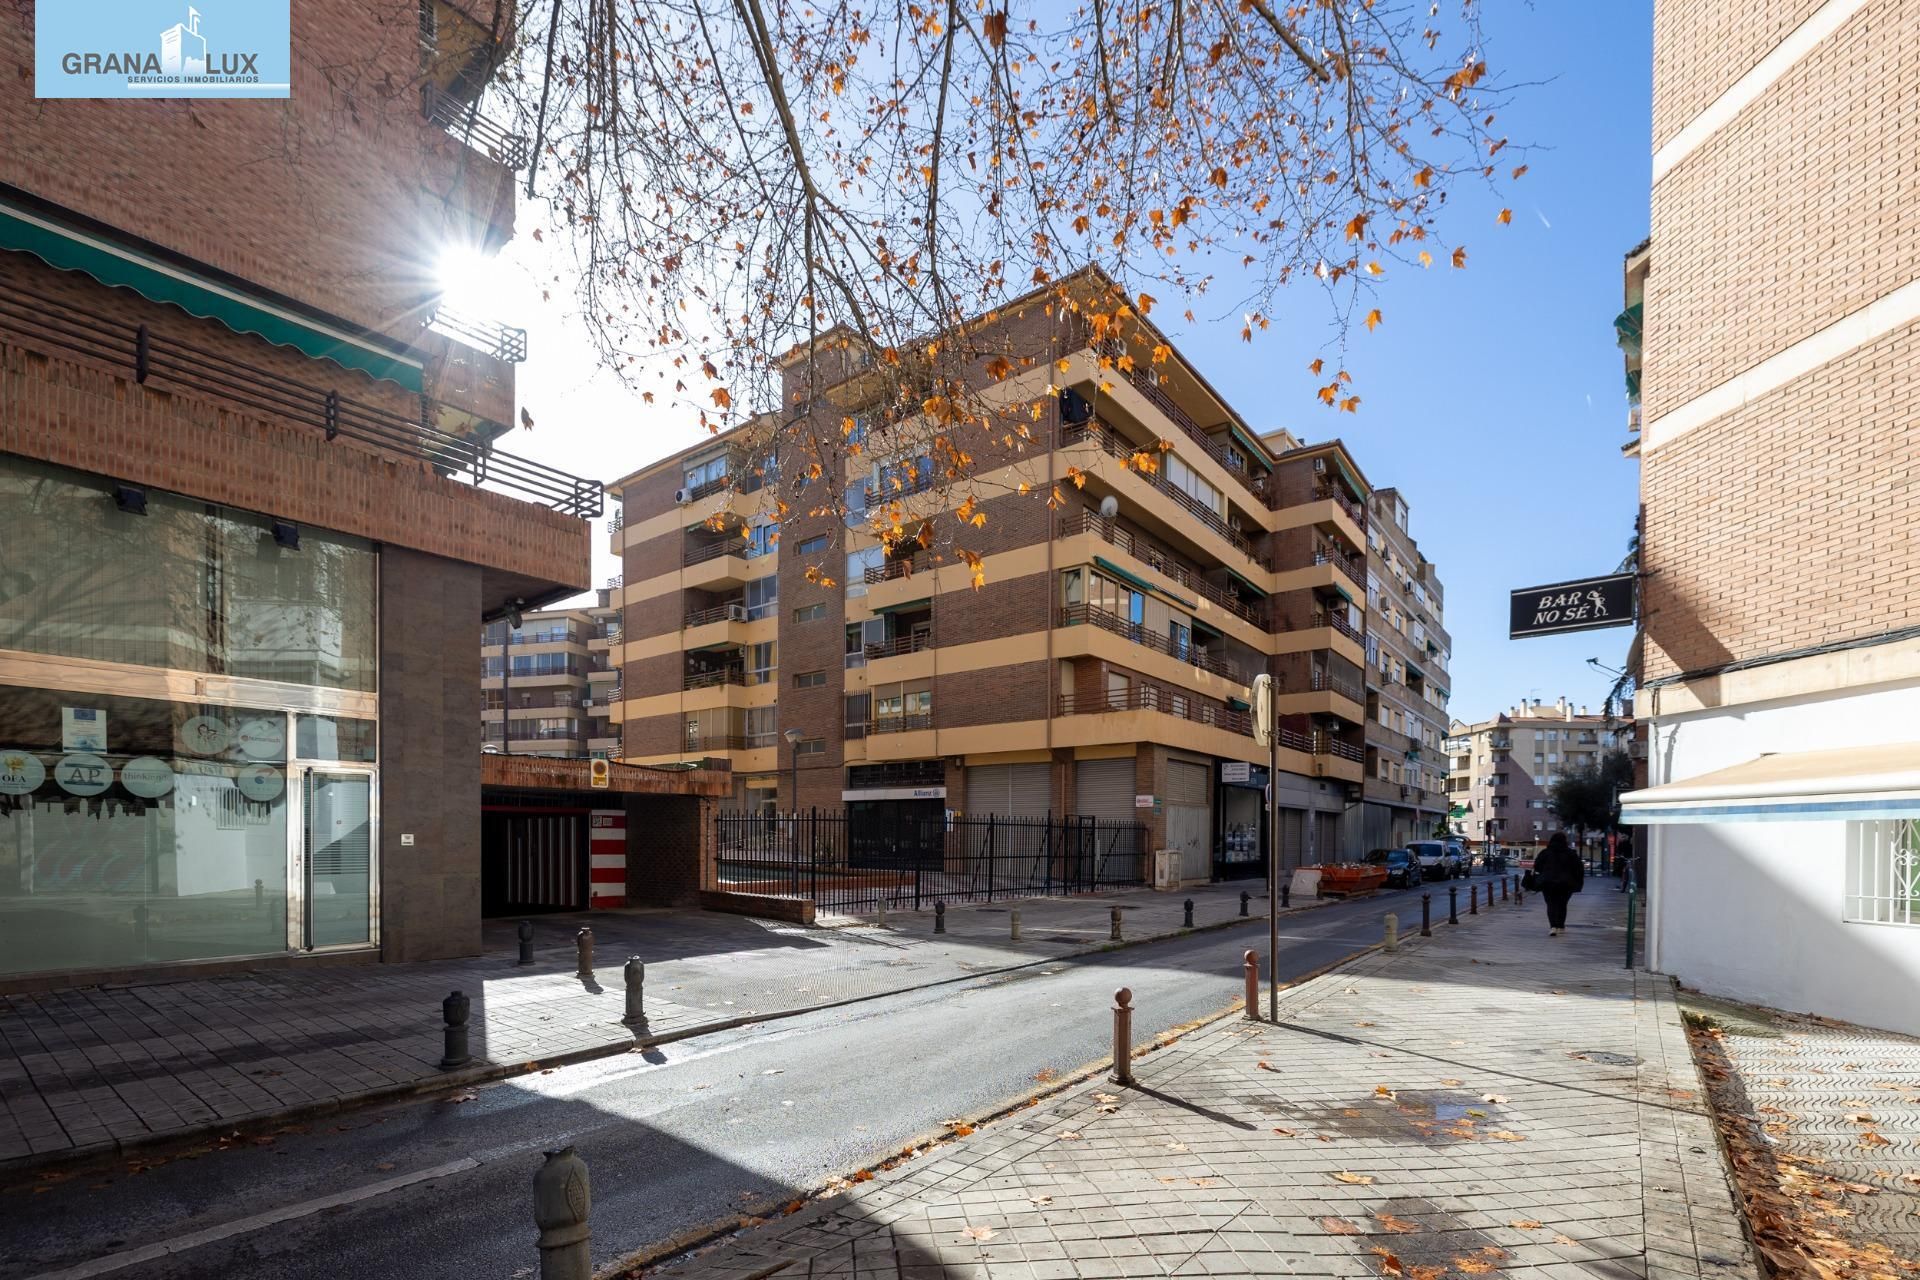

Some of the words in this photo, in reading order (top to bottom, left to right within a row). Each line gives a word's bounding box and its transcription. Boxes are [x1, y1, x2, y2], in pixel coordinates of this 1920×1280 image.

[1538, 591, 1582, 609] BAR
[1532, 610, 1560, 625] NO
[1561, 602, 1591, 621] SÉ
[69, 767, 101, 782] AP
